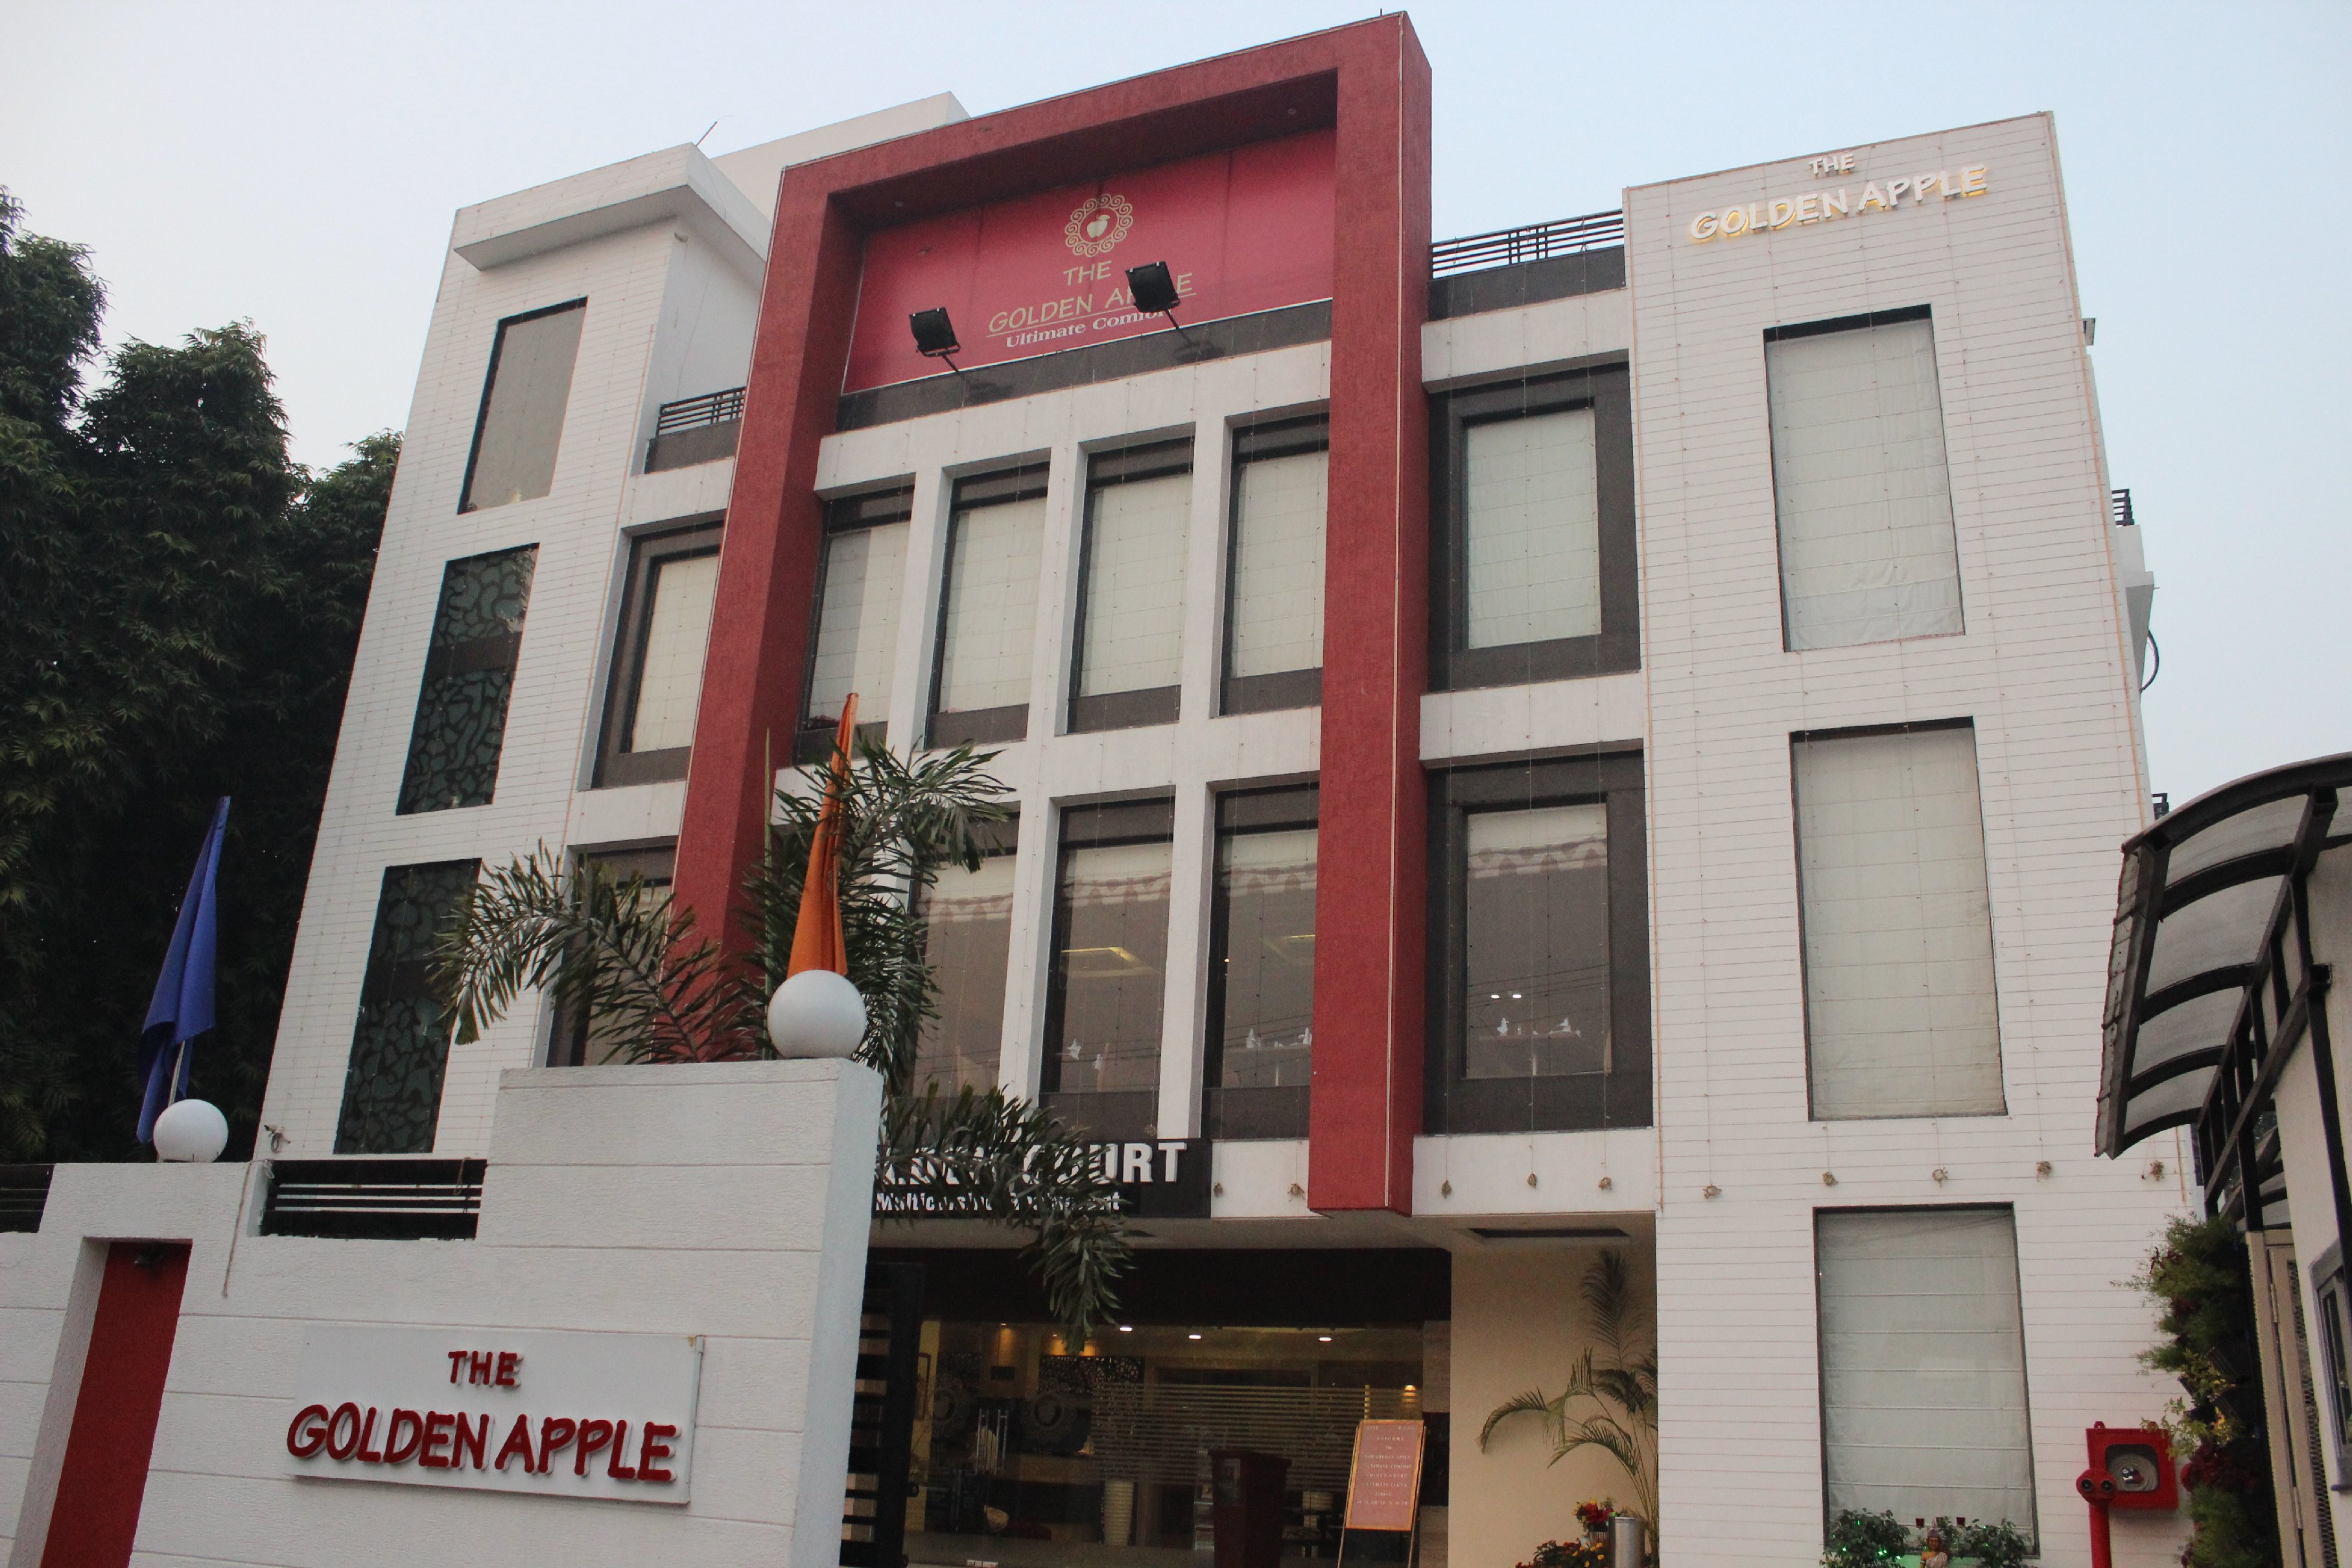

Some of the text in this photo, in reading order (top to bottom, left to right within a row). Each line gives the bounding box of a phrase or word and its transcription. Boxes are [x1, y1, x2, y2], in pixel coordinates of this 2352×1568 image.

[1809, 153, 1855, 176] THE
[1690, 163, 1988, 240] GOLDEN APPLE
[1063, 260, 1112, 286] THE
[989, 294, 1093, 333] GOLDEN
[1006, 323, 1086, 348] Ultimate
[448, 1350, 523, 1387] THE
[287, 1401, 680, 1481] GOLDEN APPLE
